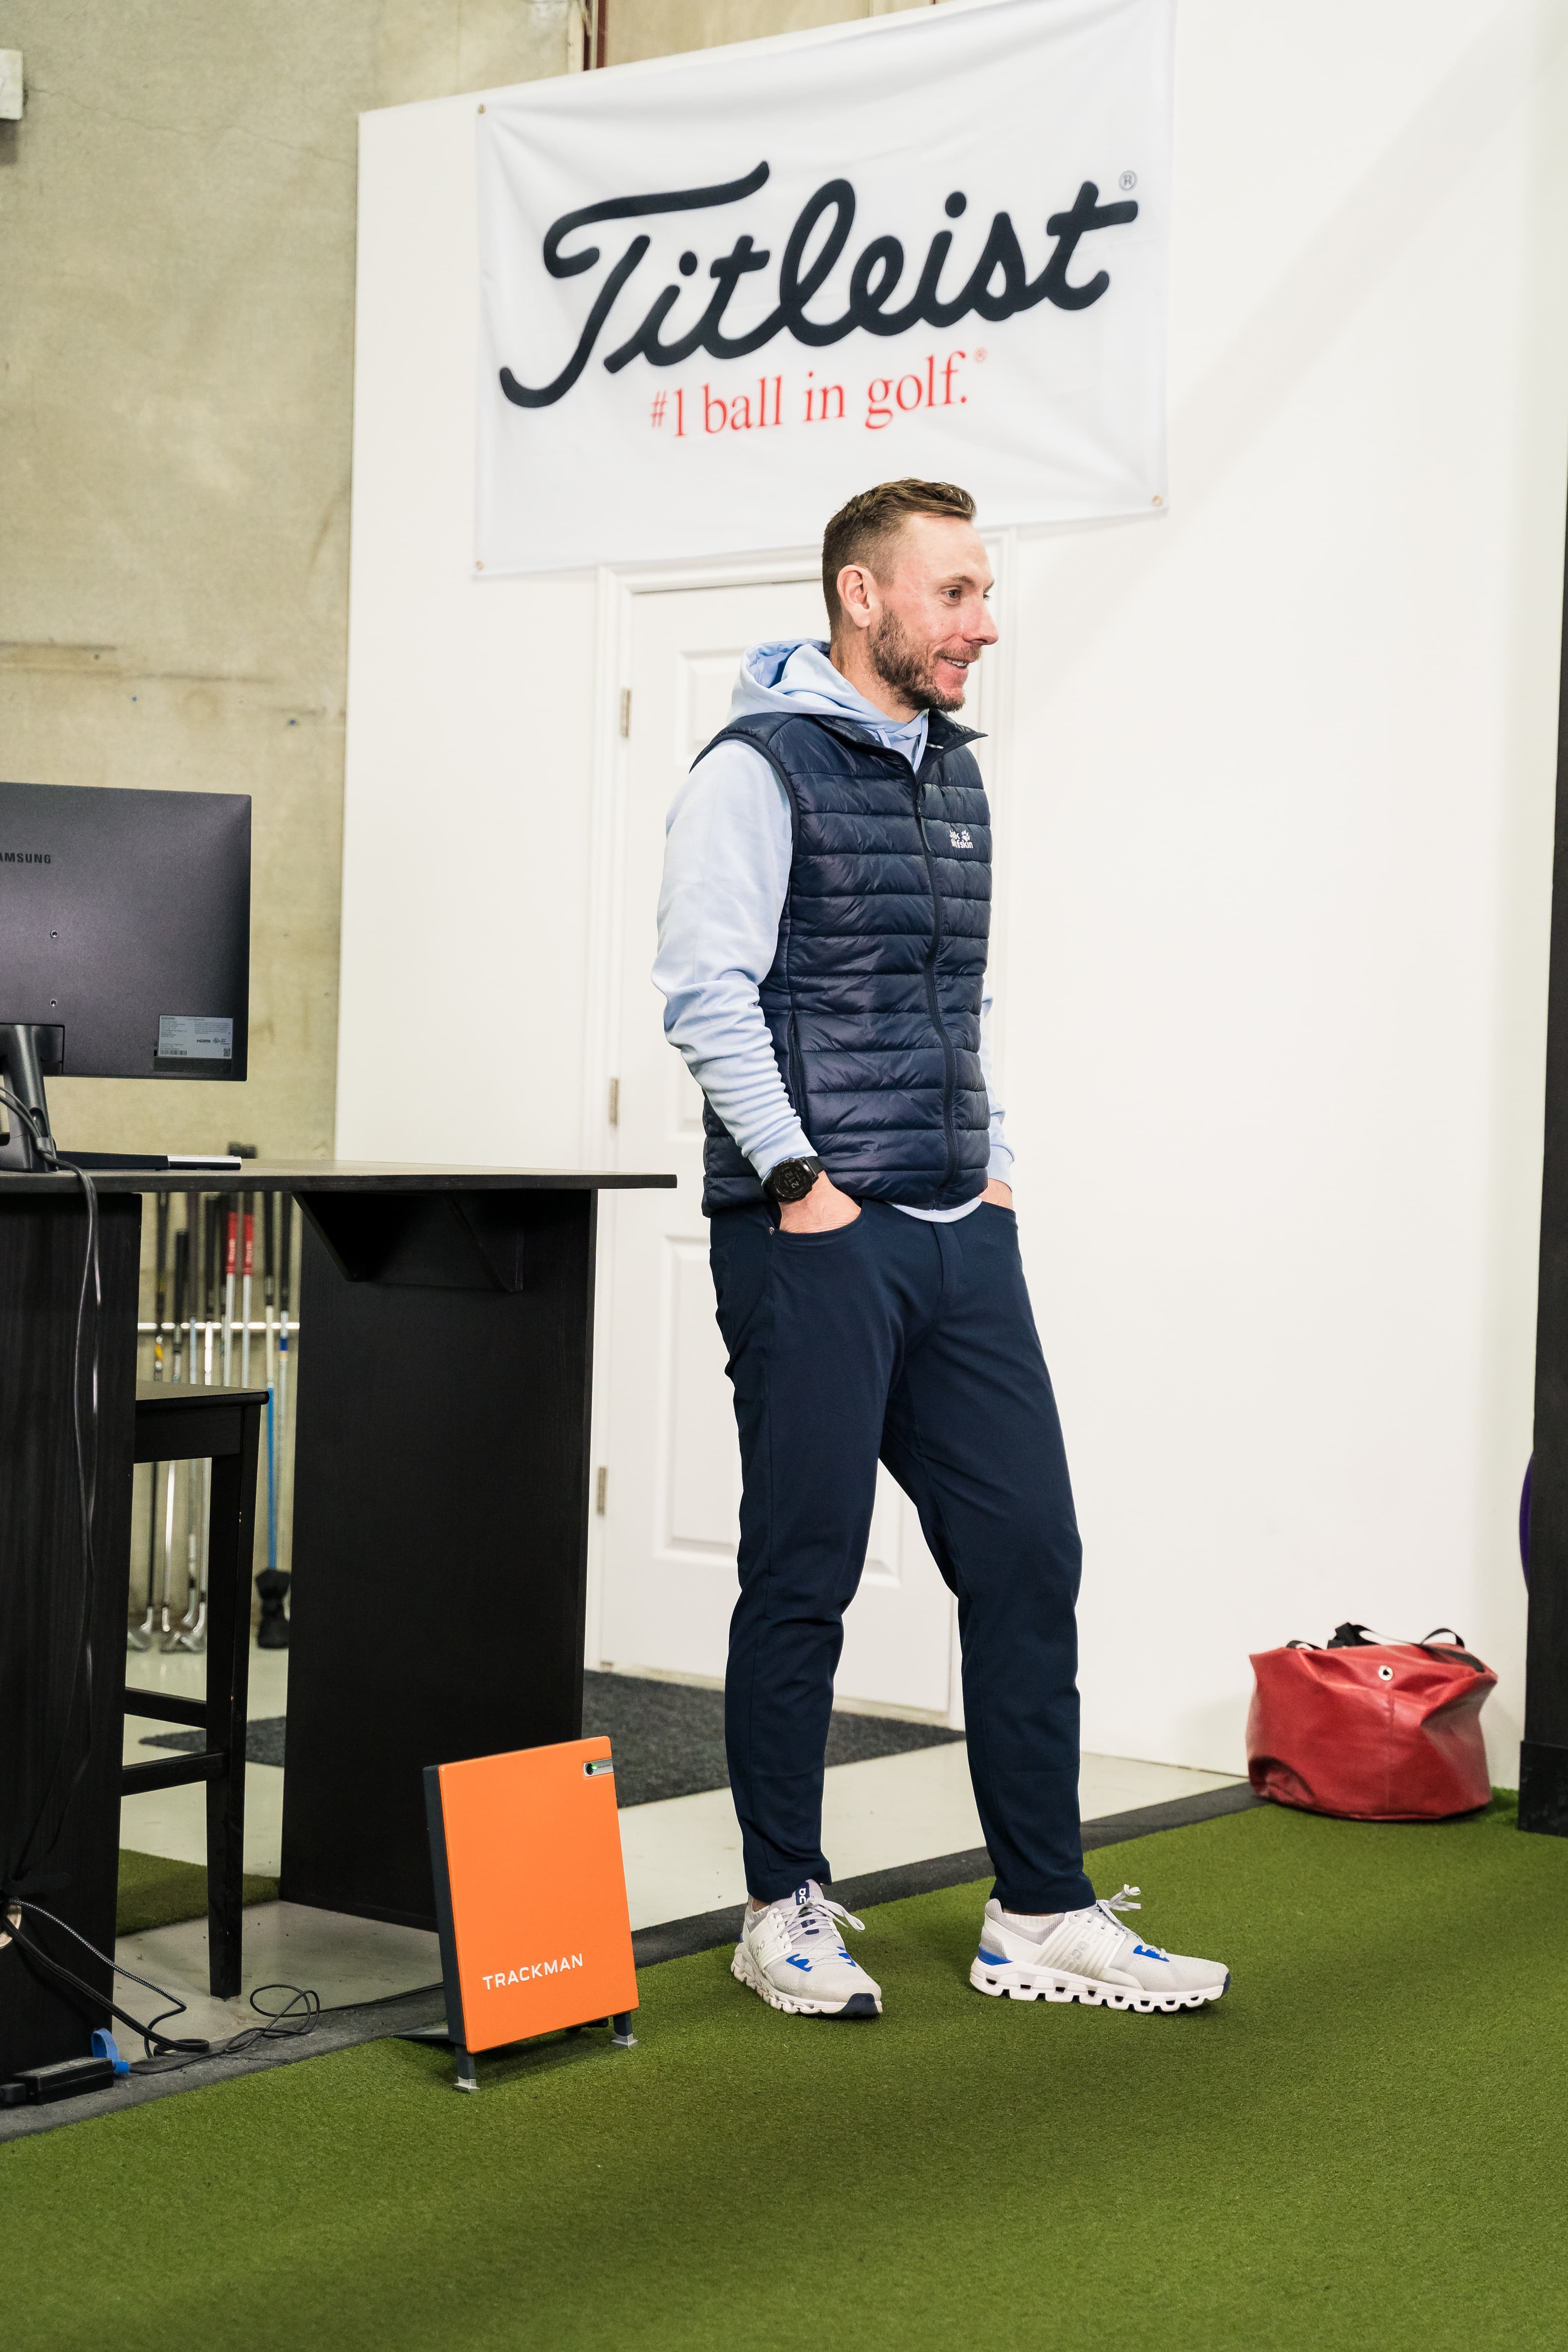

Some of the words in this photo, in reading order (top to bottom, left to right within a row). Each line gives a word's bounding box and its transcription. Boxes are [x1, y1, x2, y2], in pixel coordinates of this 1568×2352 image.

[499, 160, 1138, 408] Titleist
[650, 388, 686, 437] #1
[701, 374, 783, 435] ball
[803, 370, 846, 423] in
[951, 838, 973, 849] Wfskin
[482, 1953, 583, 1990] TRACKMAN
